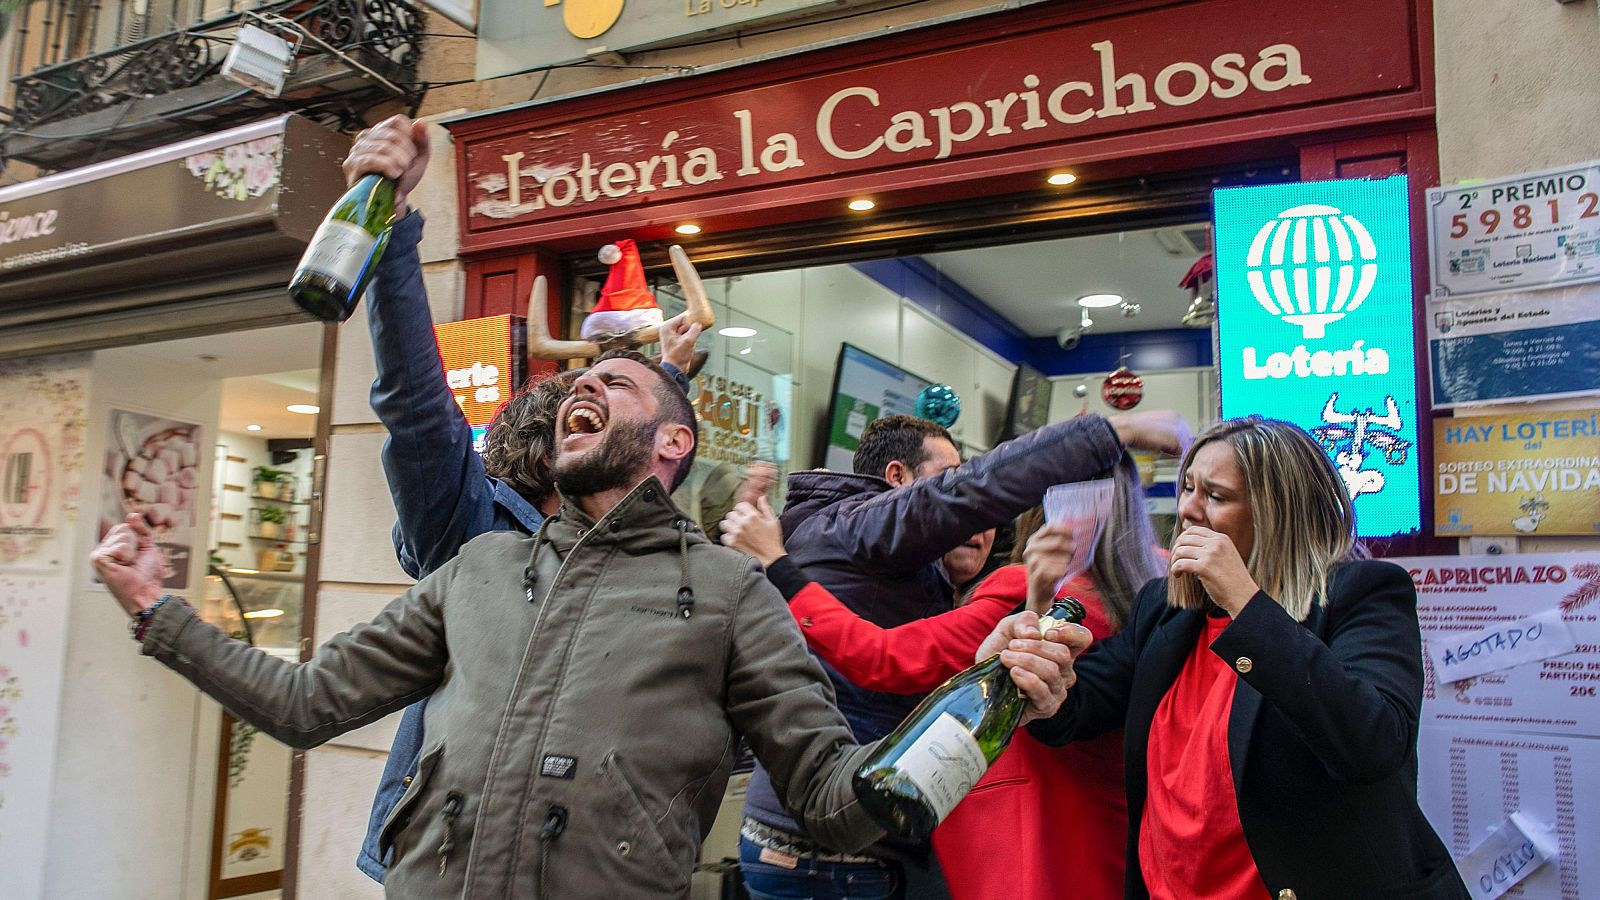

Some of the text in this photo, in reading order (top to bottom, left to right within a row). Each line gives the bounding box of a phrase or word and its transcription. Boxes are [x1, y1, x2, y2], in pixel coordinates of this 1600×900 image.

[502, 40, 1312, 211] Lotería la Caprichosa
[1491, 174, 1586, 205] PREMIO
[1450, 192, 1600, 239] 59812
[1494, 306, 1501, 315] y
[1500, 313, 1515, 321] del
[1518, 308, 1551, 319] Estado
[1243, 339, 1389, 380] Lotería
[1445, 411, 1600, 445] HAY LOTERÍ
[1523, 440, 1542, 451] del
[1439, 460, 1494, 474] SORTEO
[1439, 472, 1478, 495] DE
[1409, 565, 1567, 586] CAPRICHAZO
[1442, 622, 1543, 667] AGOTADO
[1543, 661, 1584, 670] PRECIO
[1570, 685, 1597, 698] 20€
[1480, 840, 1535, 894] OTADO
